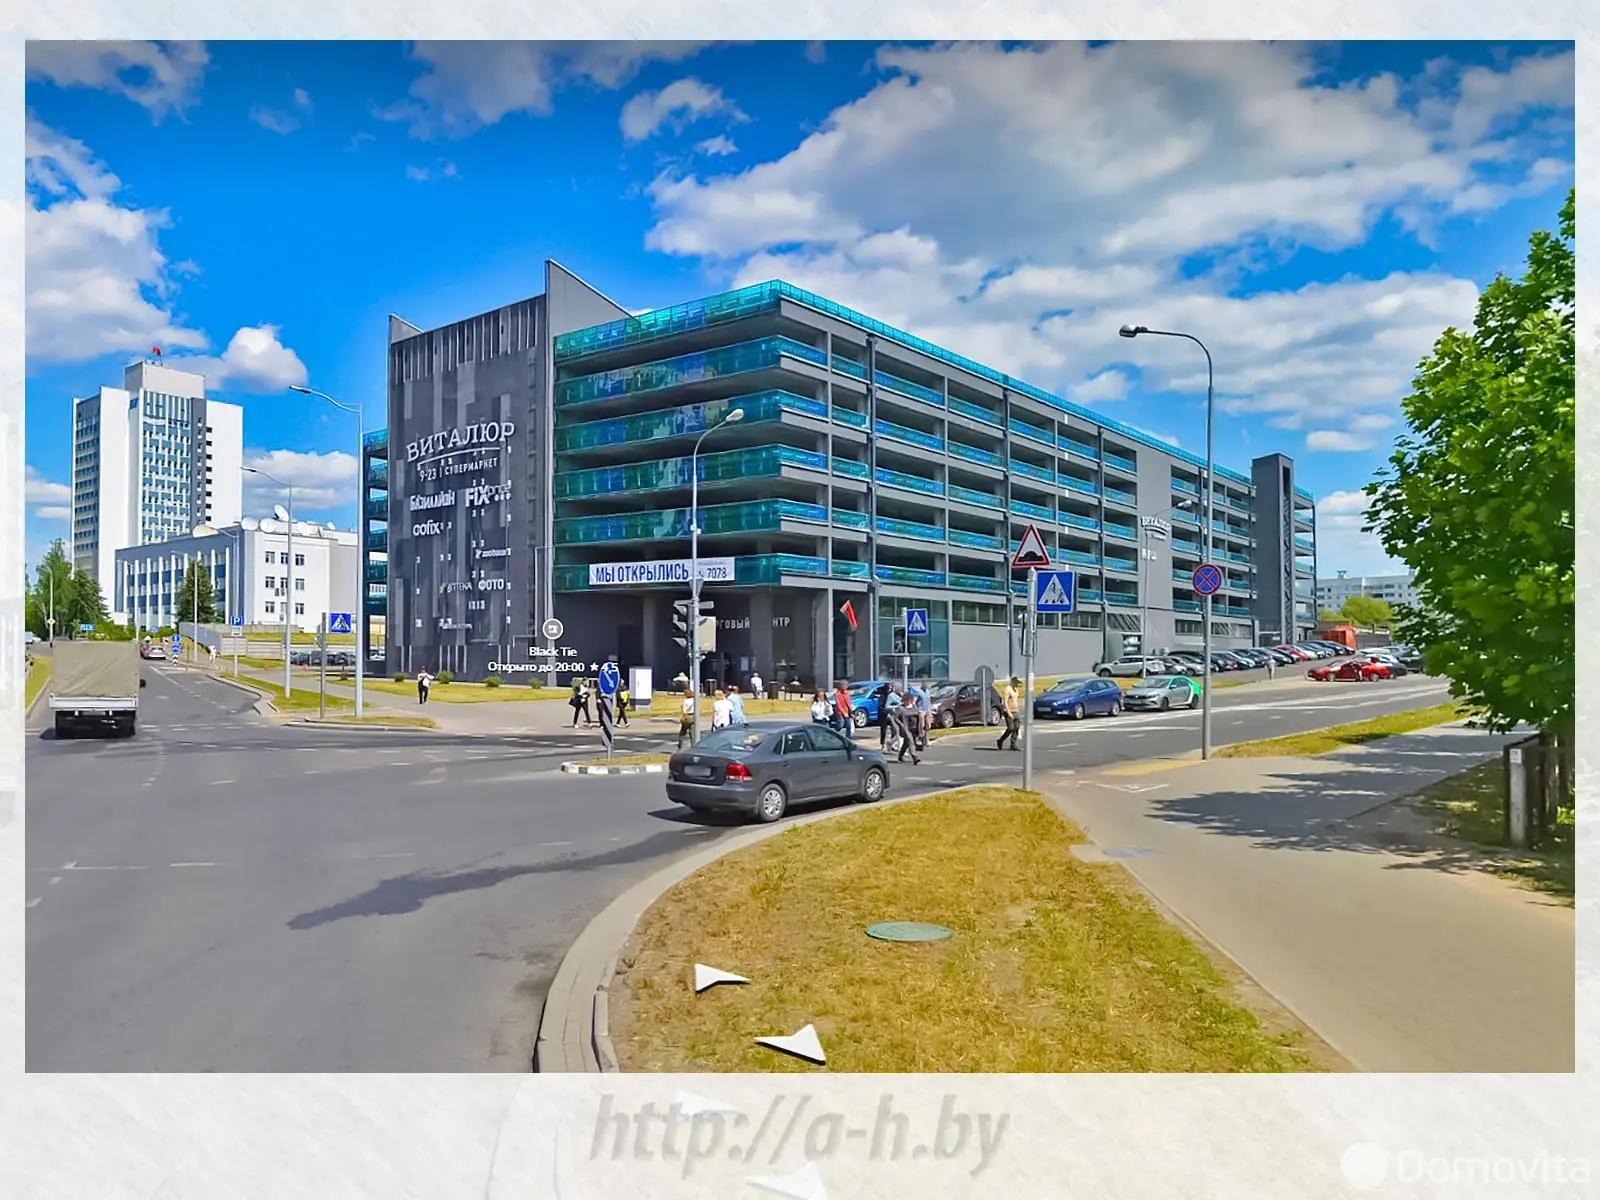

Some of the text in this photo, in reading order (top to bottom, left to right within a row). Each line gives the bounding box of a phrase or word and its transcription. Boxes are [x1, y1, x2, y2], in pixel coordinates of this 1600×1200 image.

[406, 422, 515, 462] ВИТАЛЮР
[420, 468, 437, 482] 9-23
[596, 563, 690, 583] МЫ ОТКРЫЛИСЬ
[772, 616, 790, 628] НТР
